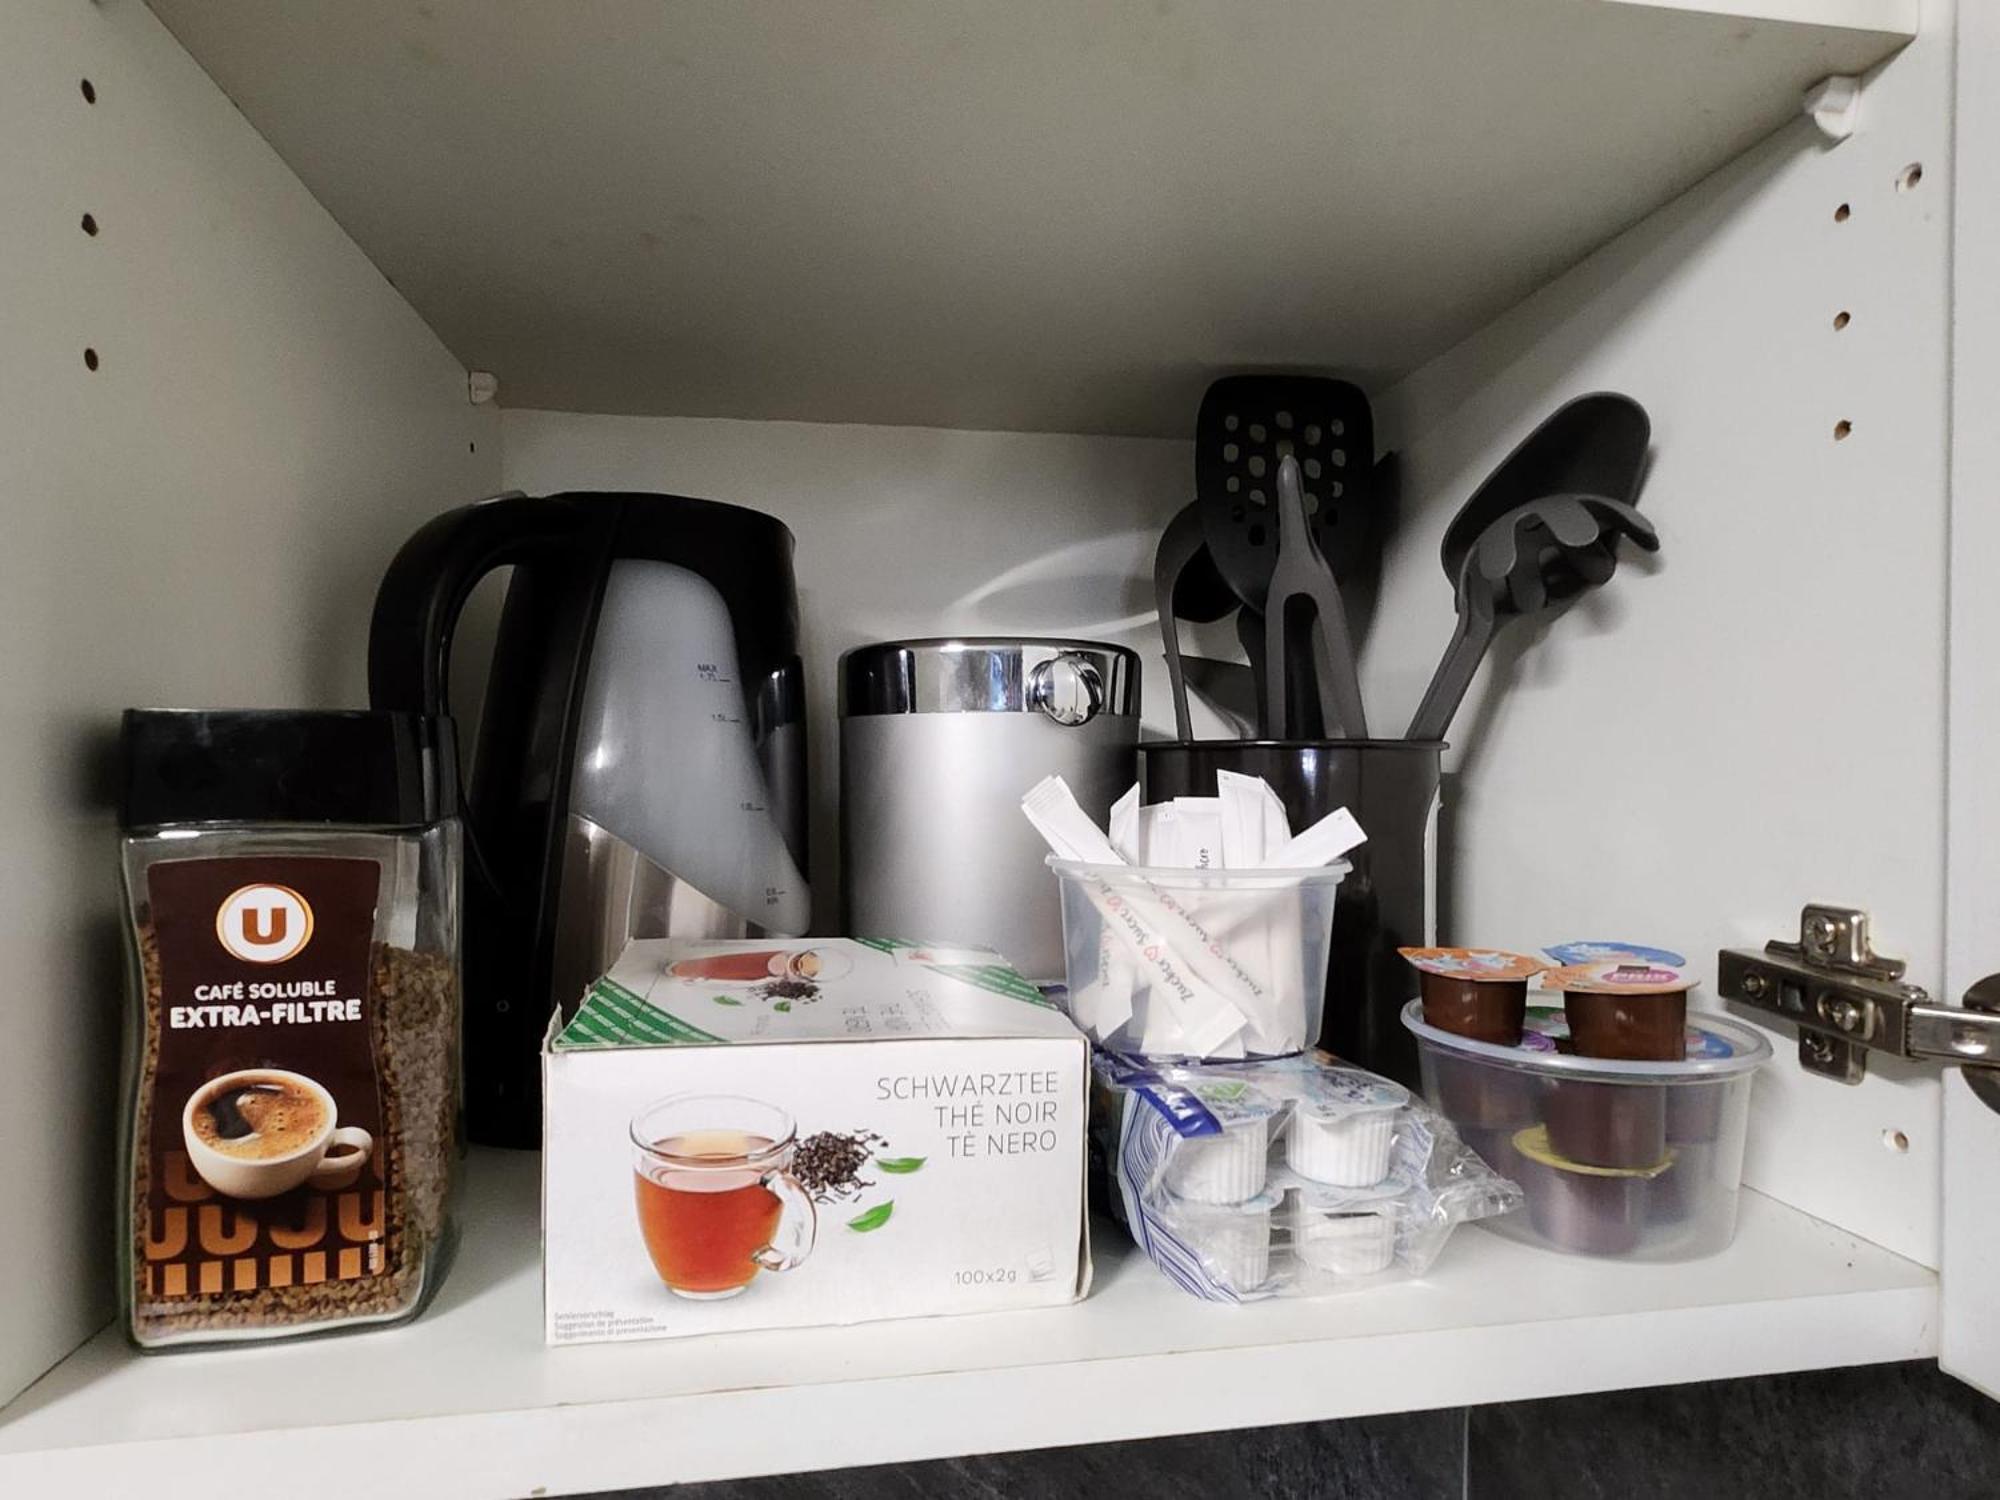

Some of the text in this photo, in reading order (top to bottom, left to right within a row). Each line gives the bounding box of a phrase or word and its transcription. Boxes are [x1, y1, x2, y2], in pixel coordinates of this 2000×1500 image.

[242, 907, 287, 945] U
[194, 980, 336, 1001] CAFÉ SOLUBLE
[170, 999, 362, 1029] EXTRA-FILTRE
[876, 1071, 1059, 1101] SCHWARZTEE
[934, 1101, 1058, 1129] THÉ NOIR
[987, 1129, 1058, 1156] NERO
[953, 1267, 1017, 1285] 100x2g
